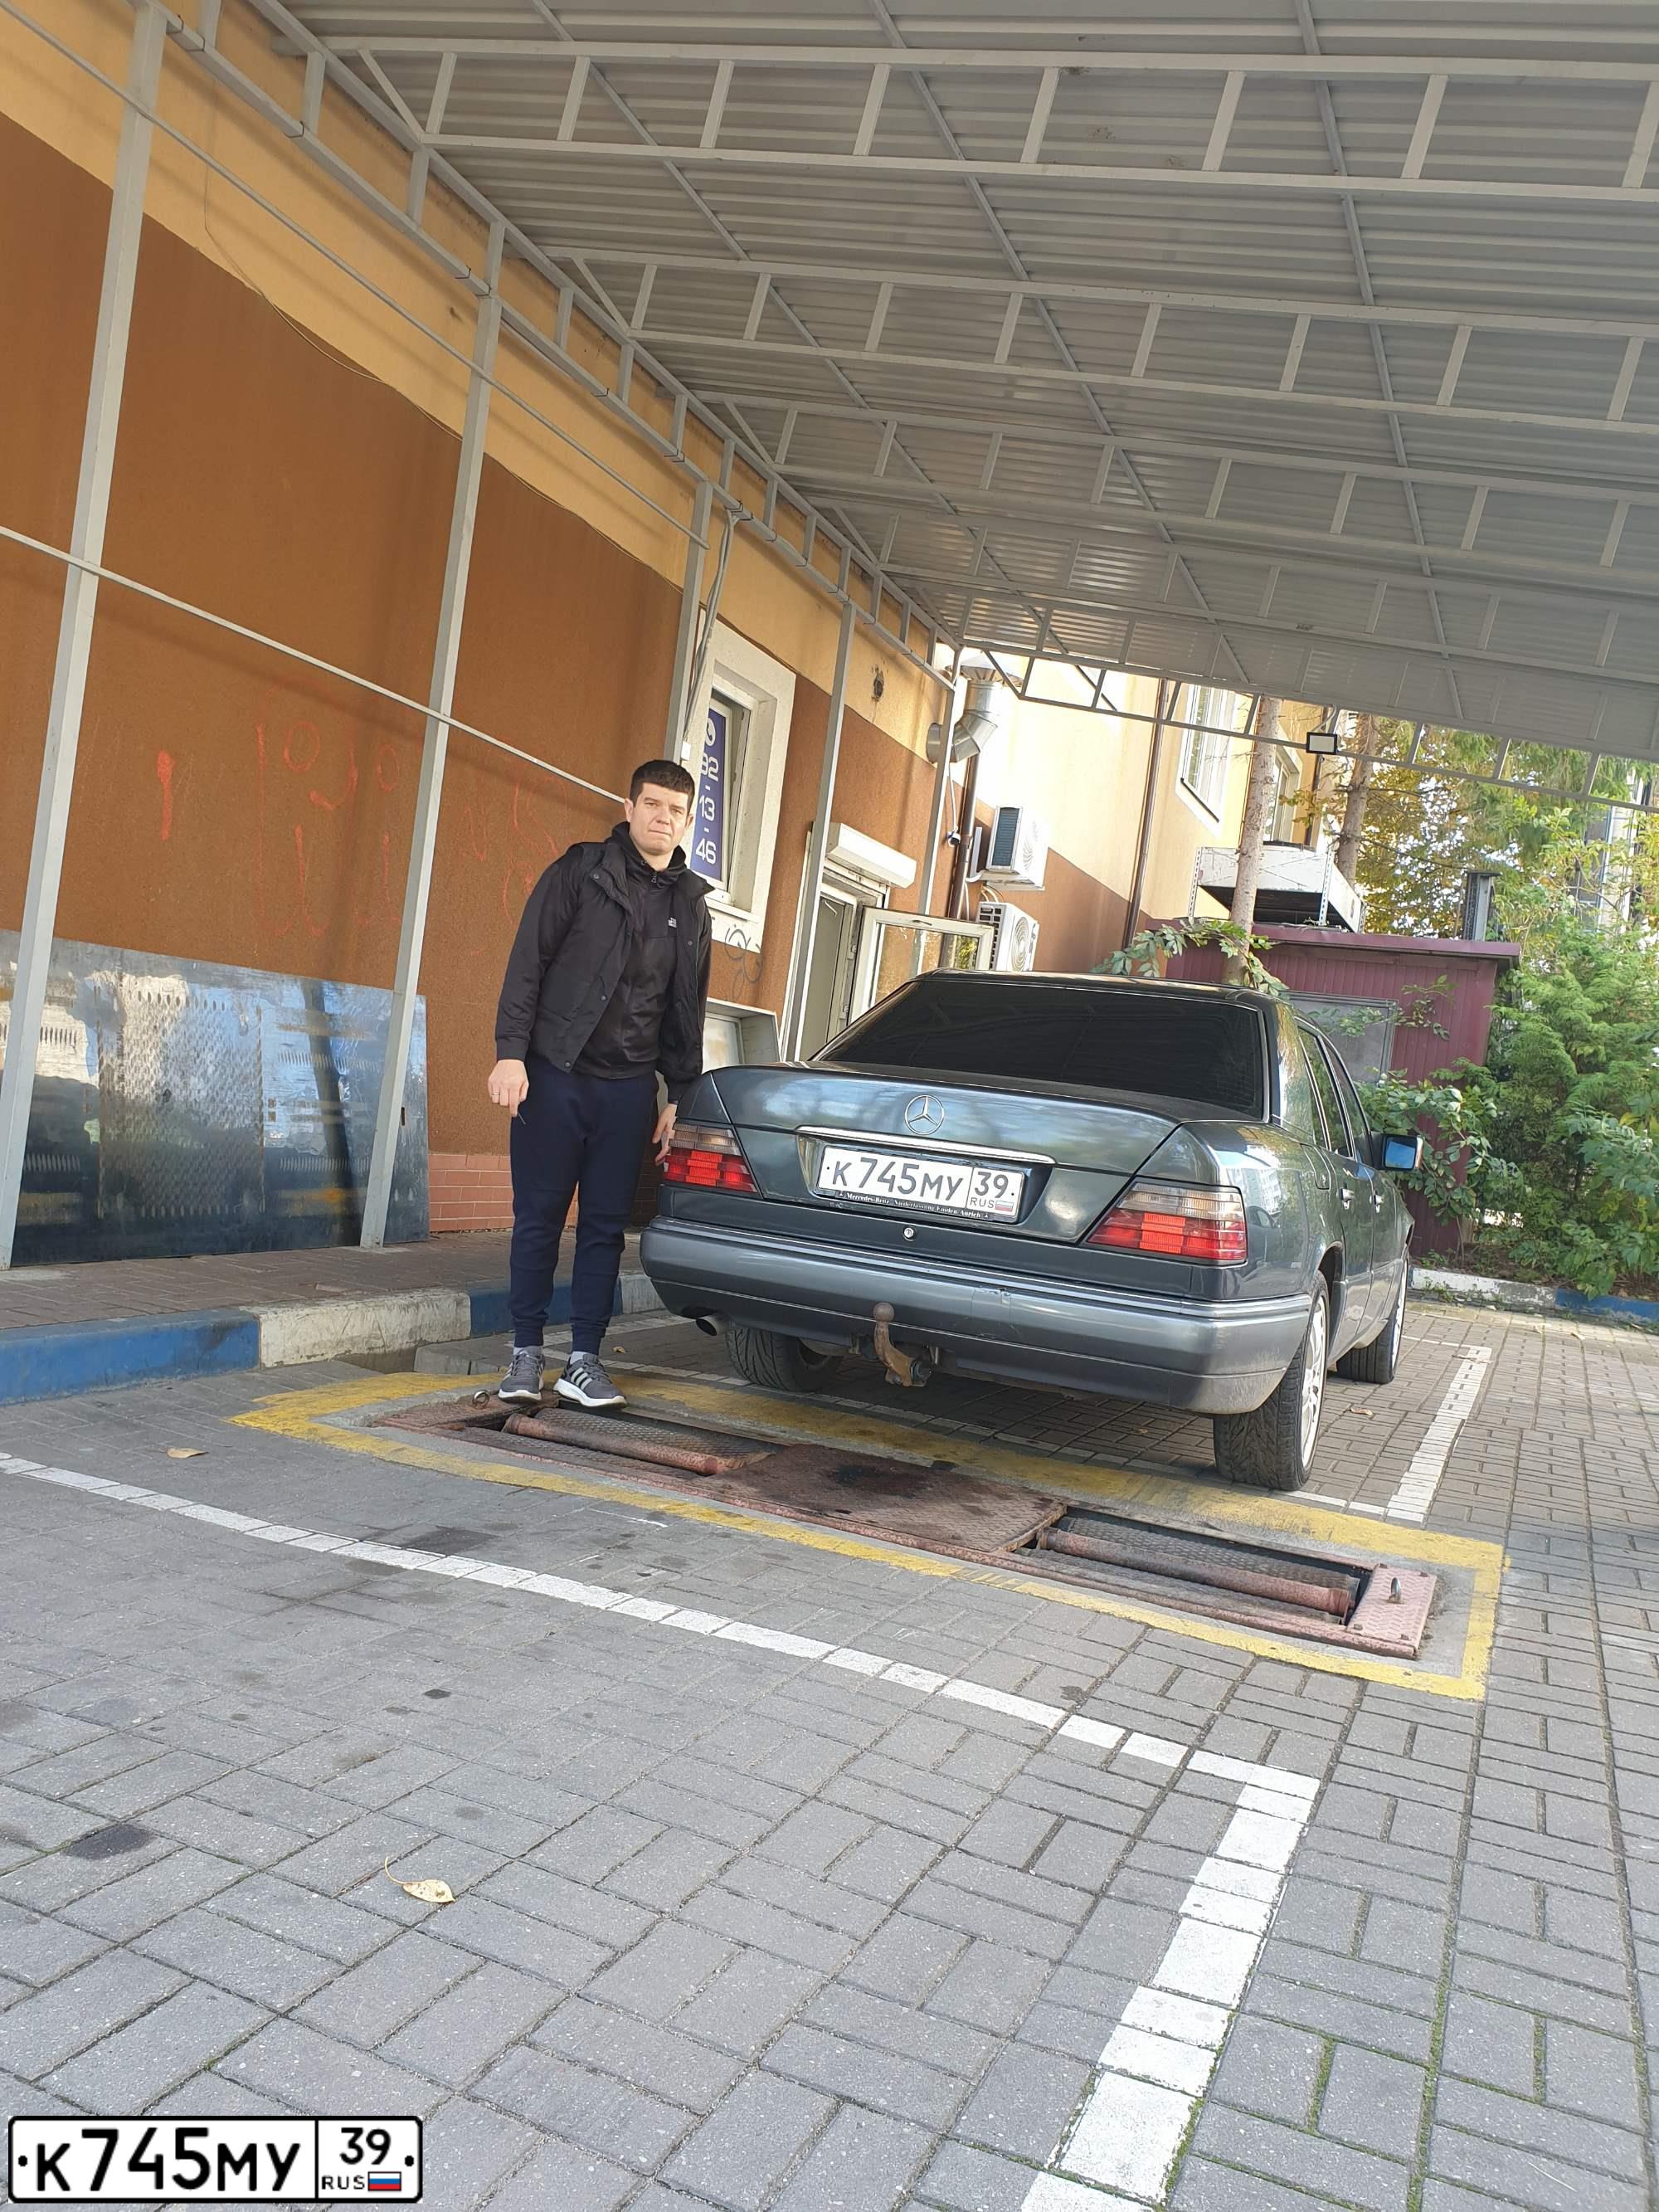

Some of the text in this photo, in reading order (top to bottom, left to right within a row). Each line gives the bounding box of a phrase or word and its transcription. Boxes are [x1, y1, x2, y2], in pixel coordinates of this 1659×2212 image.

[699, 794, 715, 821] 13
[695, 837, 717, 865] 46
[832, 1157, 1010, 1201] К745МУ 39
[846, 1192, 890, 1205] Mercedes-Benz
[970, 1197, 995, 1209] RUS
